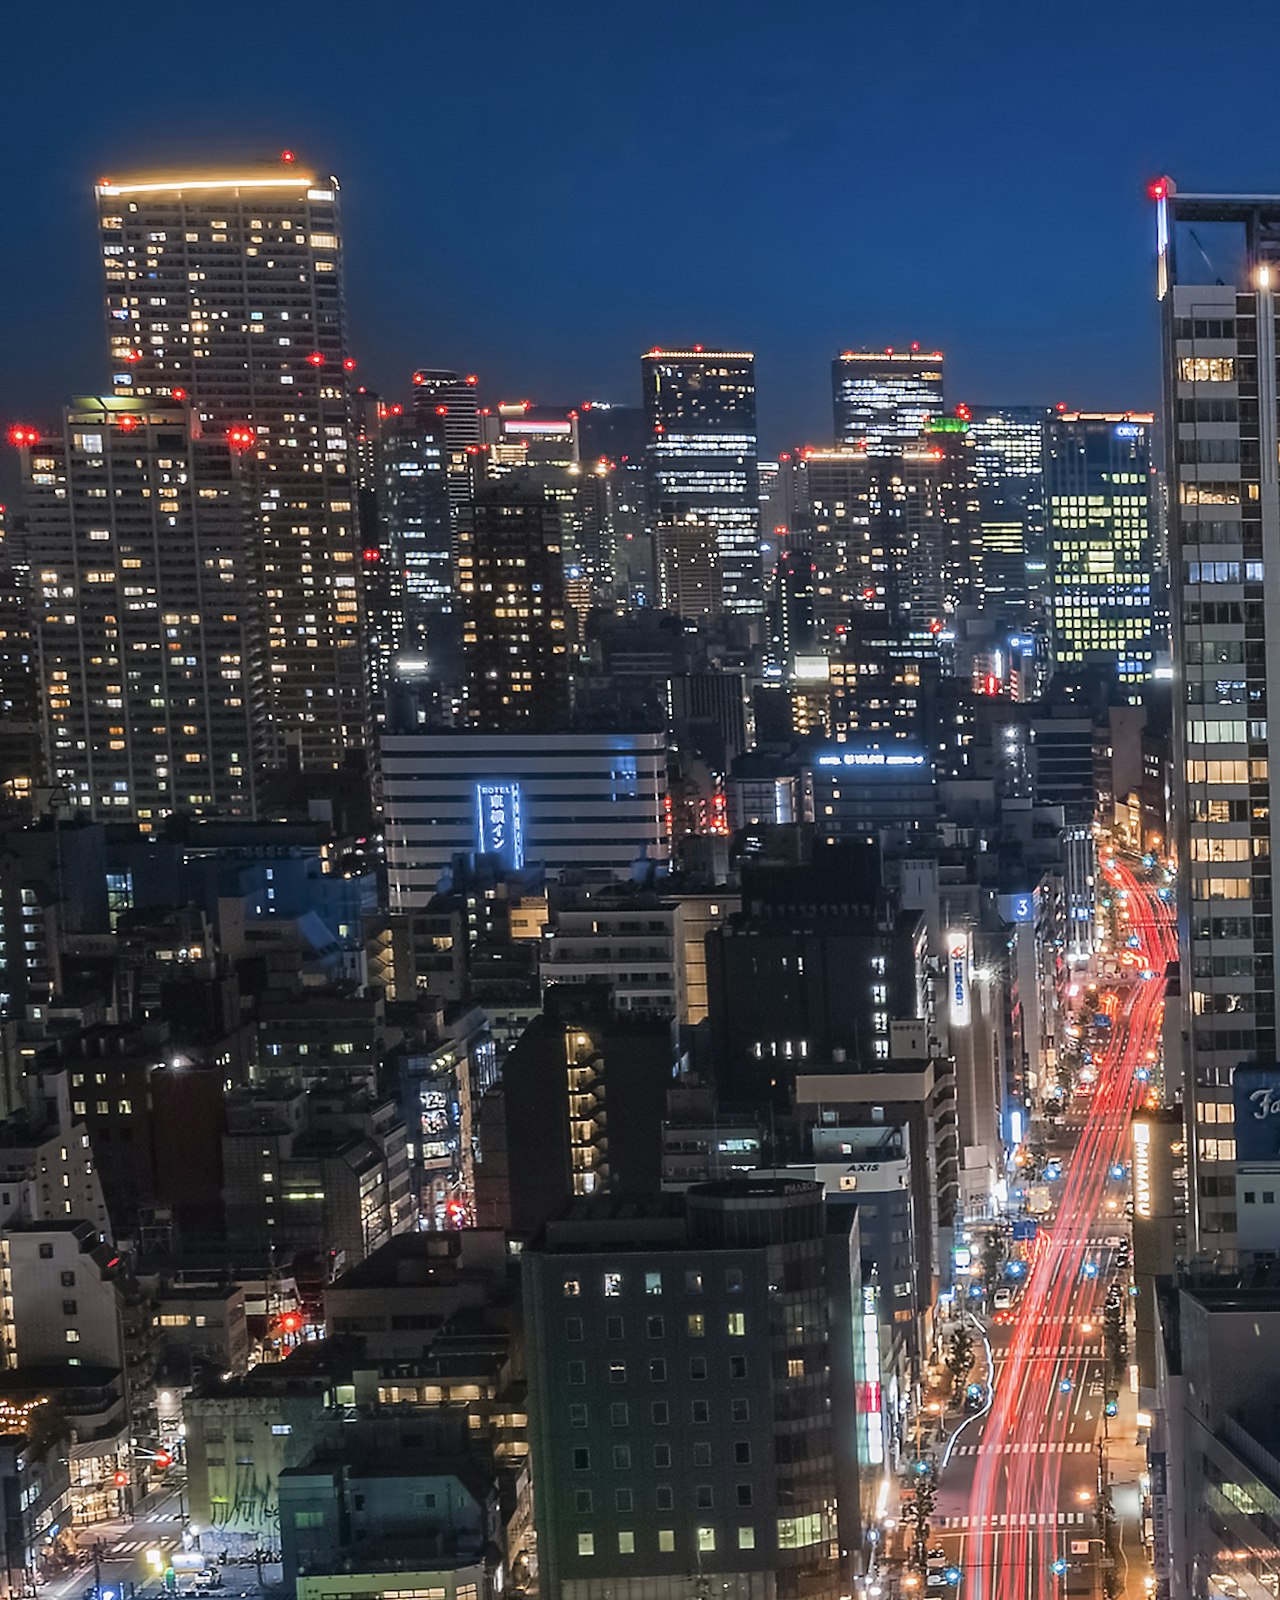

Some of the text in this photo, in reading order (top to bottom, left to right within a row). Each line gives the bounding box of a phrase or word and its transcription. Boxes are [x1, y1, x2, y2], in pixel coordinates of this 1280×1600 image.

[1016, 898, 1028, 915] 3
[847, 1164, 880, 1173] AXIS
[1136, 1142, 1150, 1216] MIMARU
